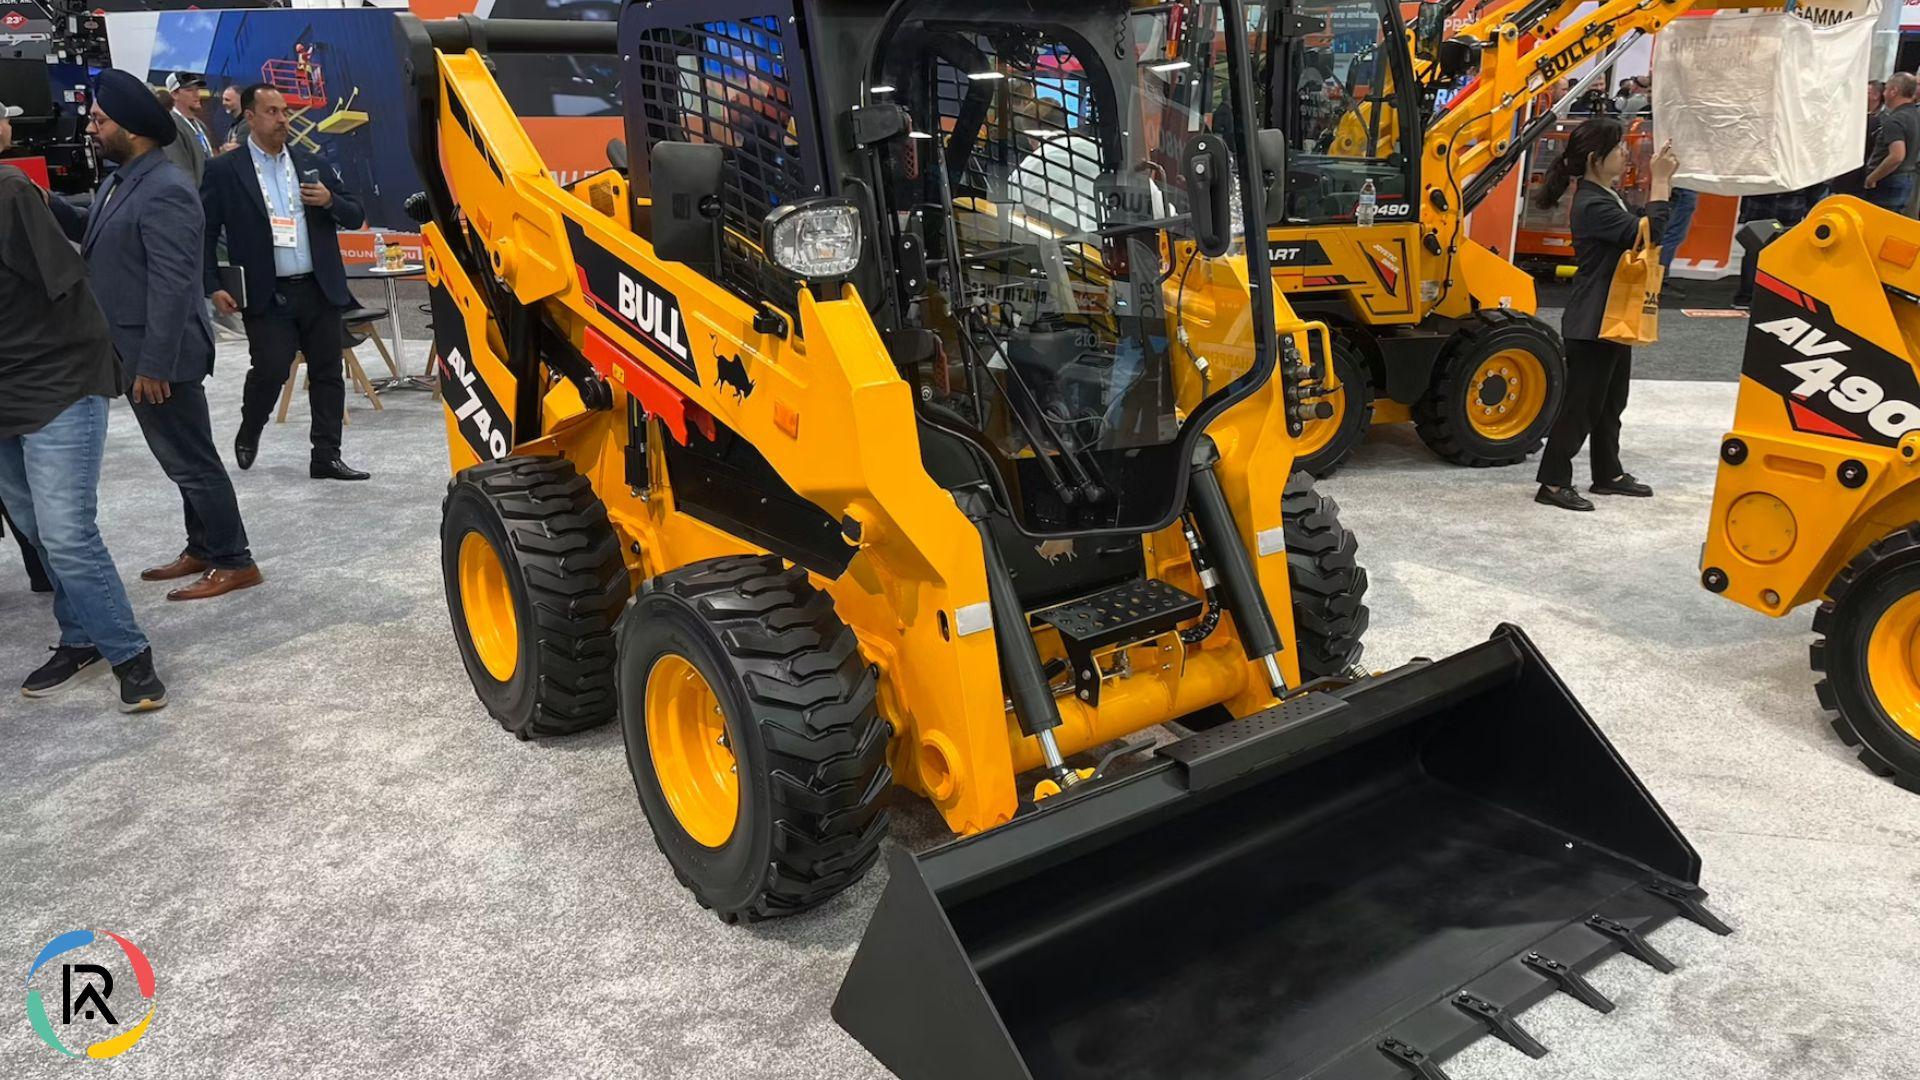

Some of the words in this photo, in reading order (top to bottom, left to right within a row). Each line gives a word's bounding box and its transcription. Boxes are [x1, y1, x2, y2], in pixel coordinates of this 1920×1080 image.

[1542, 40, 1593, 81] BULL
[618, 271, 688, 360] BULL
[1754, 316, 1852, 357] AV
[447, 346, 476, 388] AV
[455, 385, 507, 459] 740
[1780, 357, 1920, 439] 490
